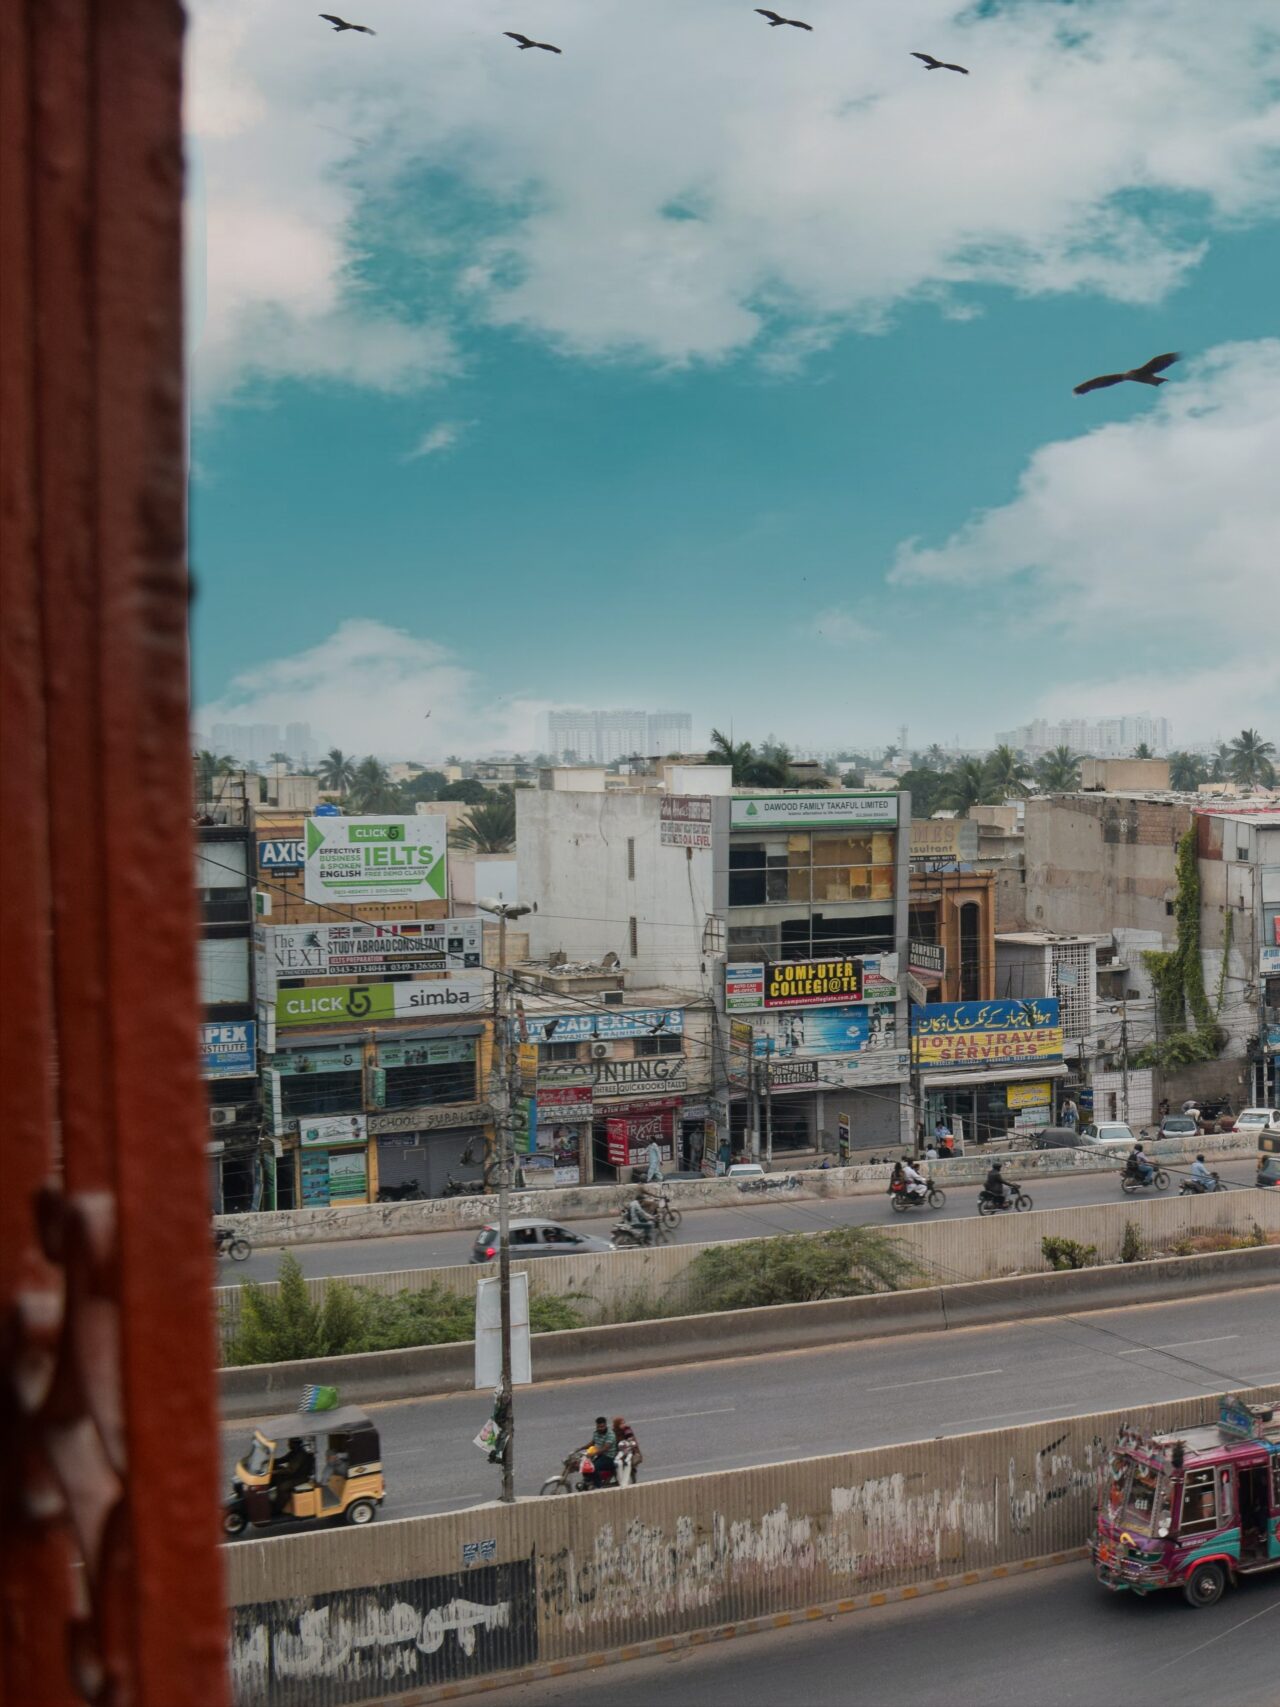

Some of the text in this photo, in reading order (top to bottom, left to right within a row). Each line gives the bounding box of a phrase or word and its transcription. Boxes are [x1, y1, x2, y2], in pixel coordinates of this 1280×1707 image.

[764, 800, 888, 812] DAWOOD FAMILY TAKAFUL LIMITED
[262, 842, 305, 862] AXIS
[364, 846, 434, 866] IELTS
[319, 870, 362, 878] ENGLISH
[328, 937, 446, 955] STUDY ABROAD CONSULTANT
[275, 948, 326, 968] NEXT
[770, 976, 857, 997] COLLEGI@TE
[286, 996, 343, 1014] CLICK
[410, 988, 470, 1008] simba
[202, 1042, 246, 1054] NSTITUTE
[920, 1030, 1057, 1049] TOTAL TRAVEL
[940, 1043, 1038, 1060] SERVICES
[620, 1080, 686, 1092] QUICKBOOKS TALLY
[371, 1116, 418, 1130] SCHOOL
[626, 1122, 664, 1137] TRAVEL
